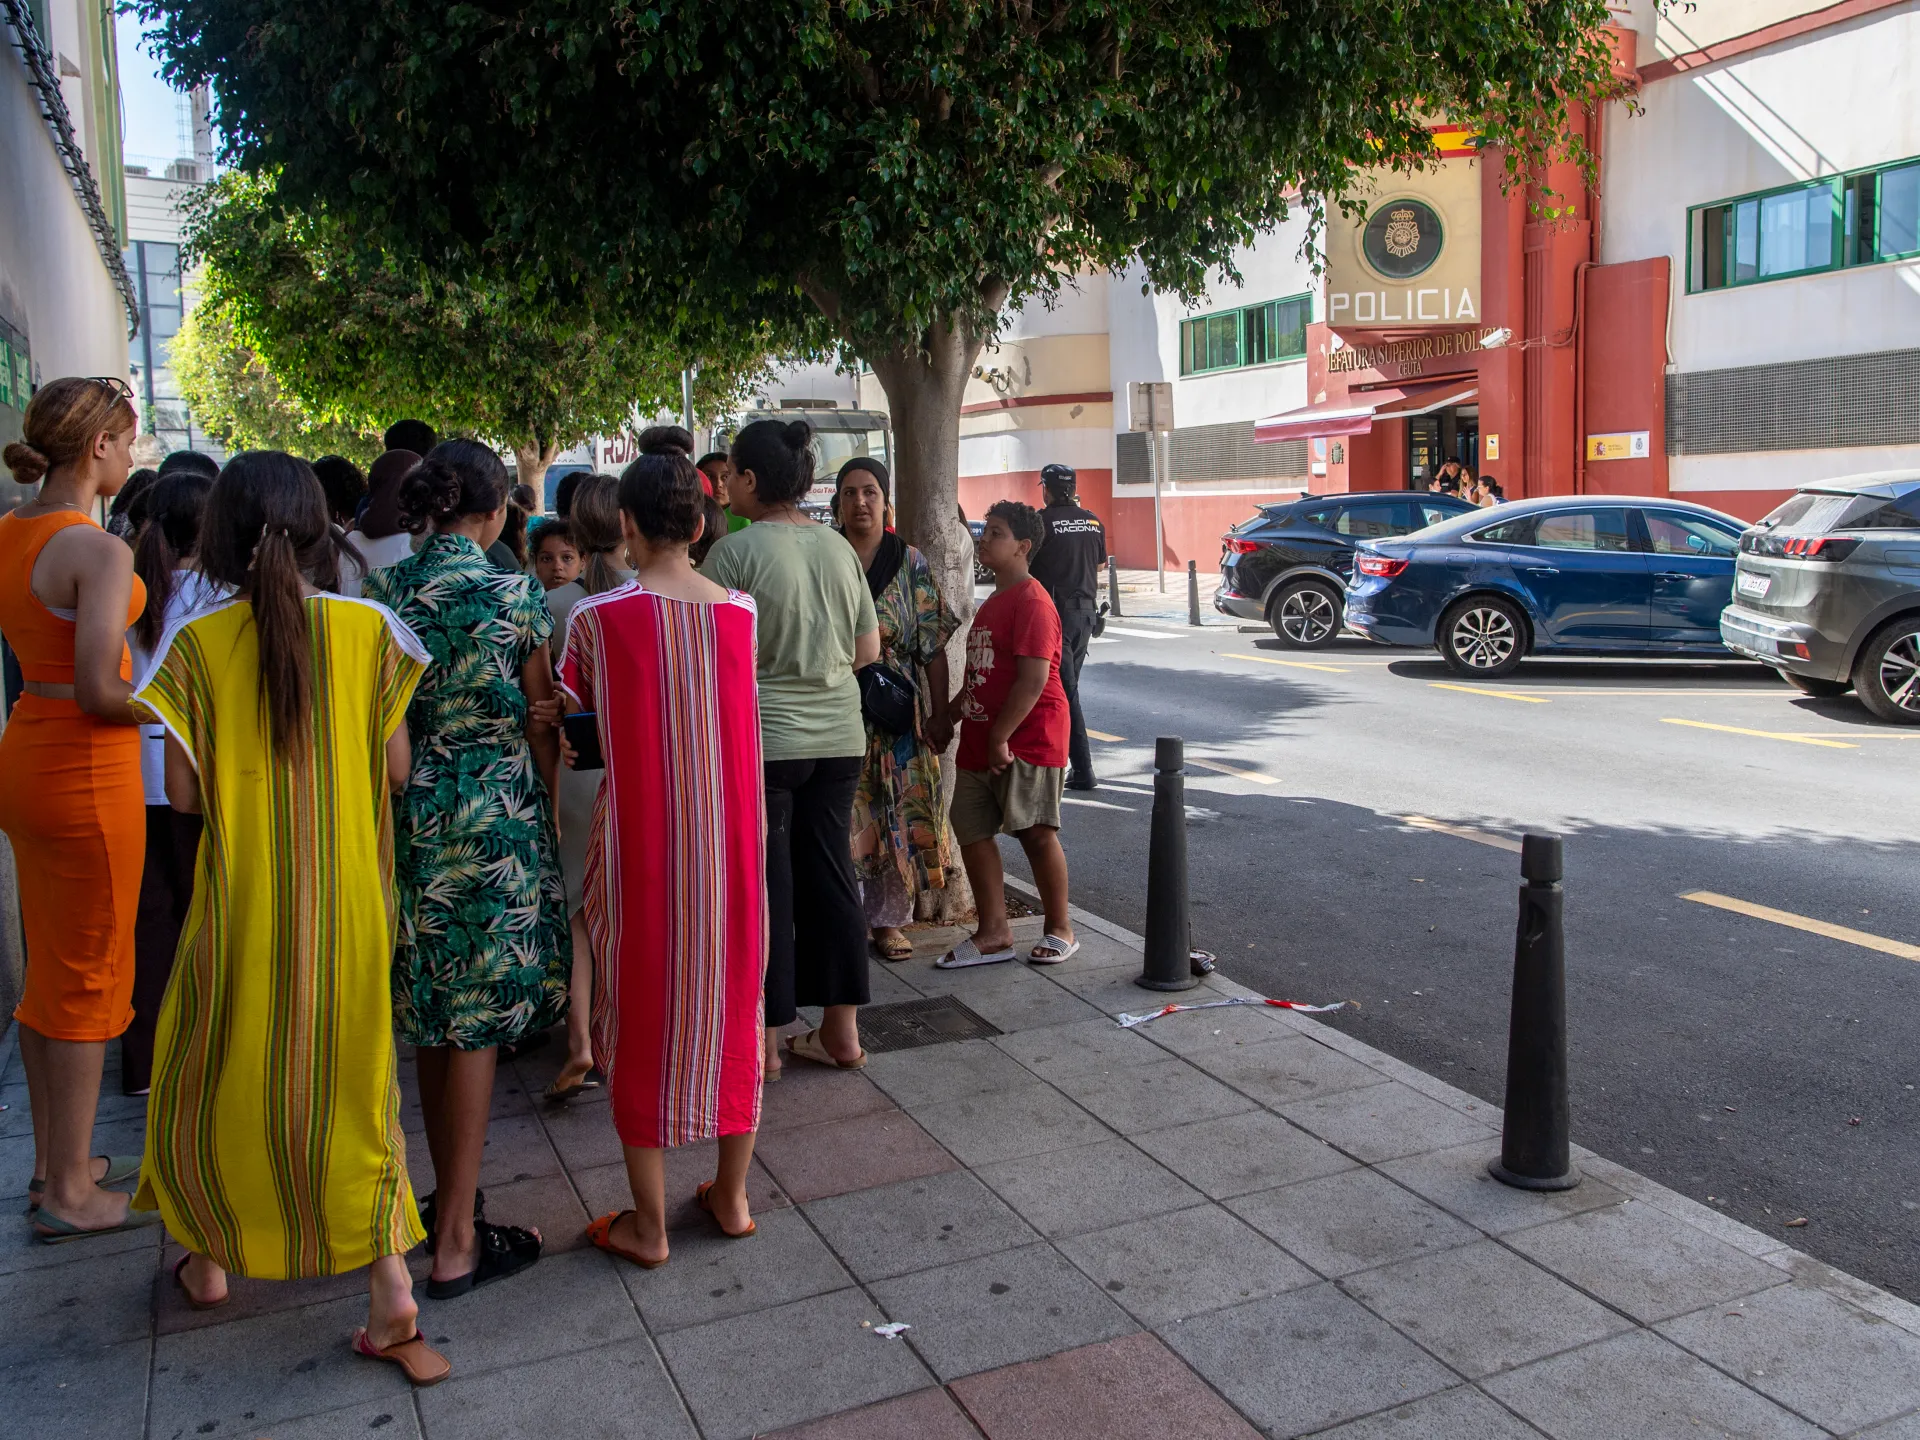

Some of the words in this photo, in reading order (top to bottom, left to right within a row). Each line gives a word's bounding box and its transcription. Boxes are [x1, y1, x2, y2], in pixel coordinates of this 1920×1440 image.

[1330, 287, 1476, 322] POLICIA
[1379, 339, 1433, 365] SUPERIOR
[1437, 334, 1453, 357] DE
[1398, 361, 1422, 376] CEUTA
[809, 511, 834, 520] MA
[1052, 519, 1092, 527] POLICIA
[1054, 526, 1101, 534] NACIONAL
